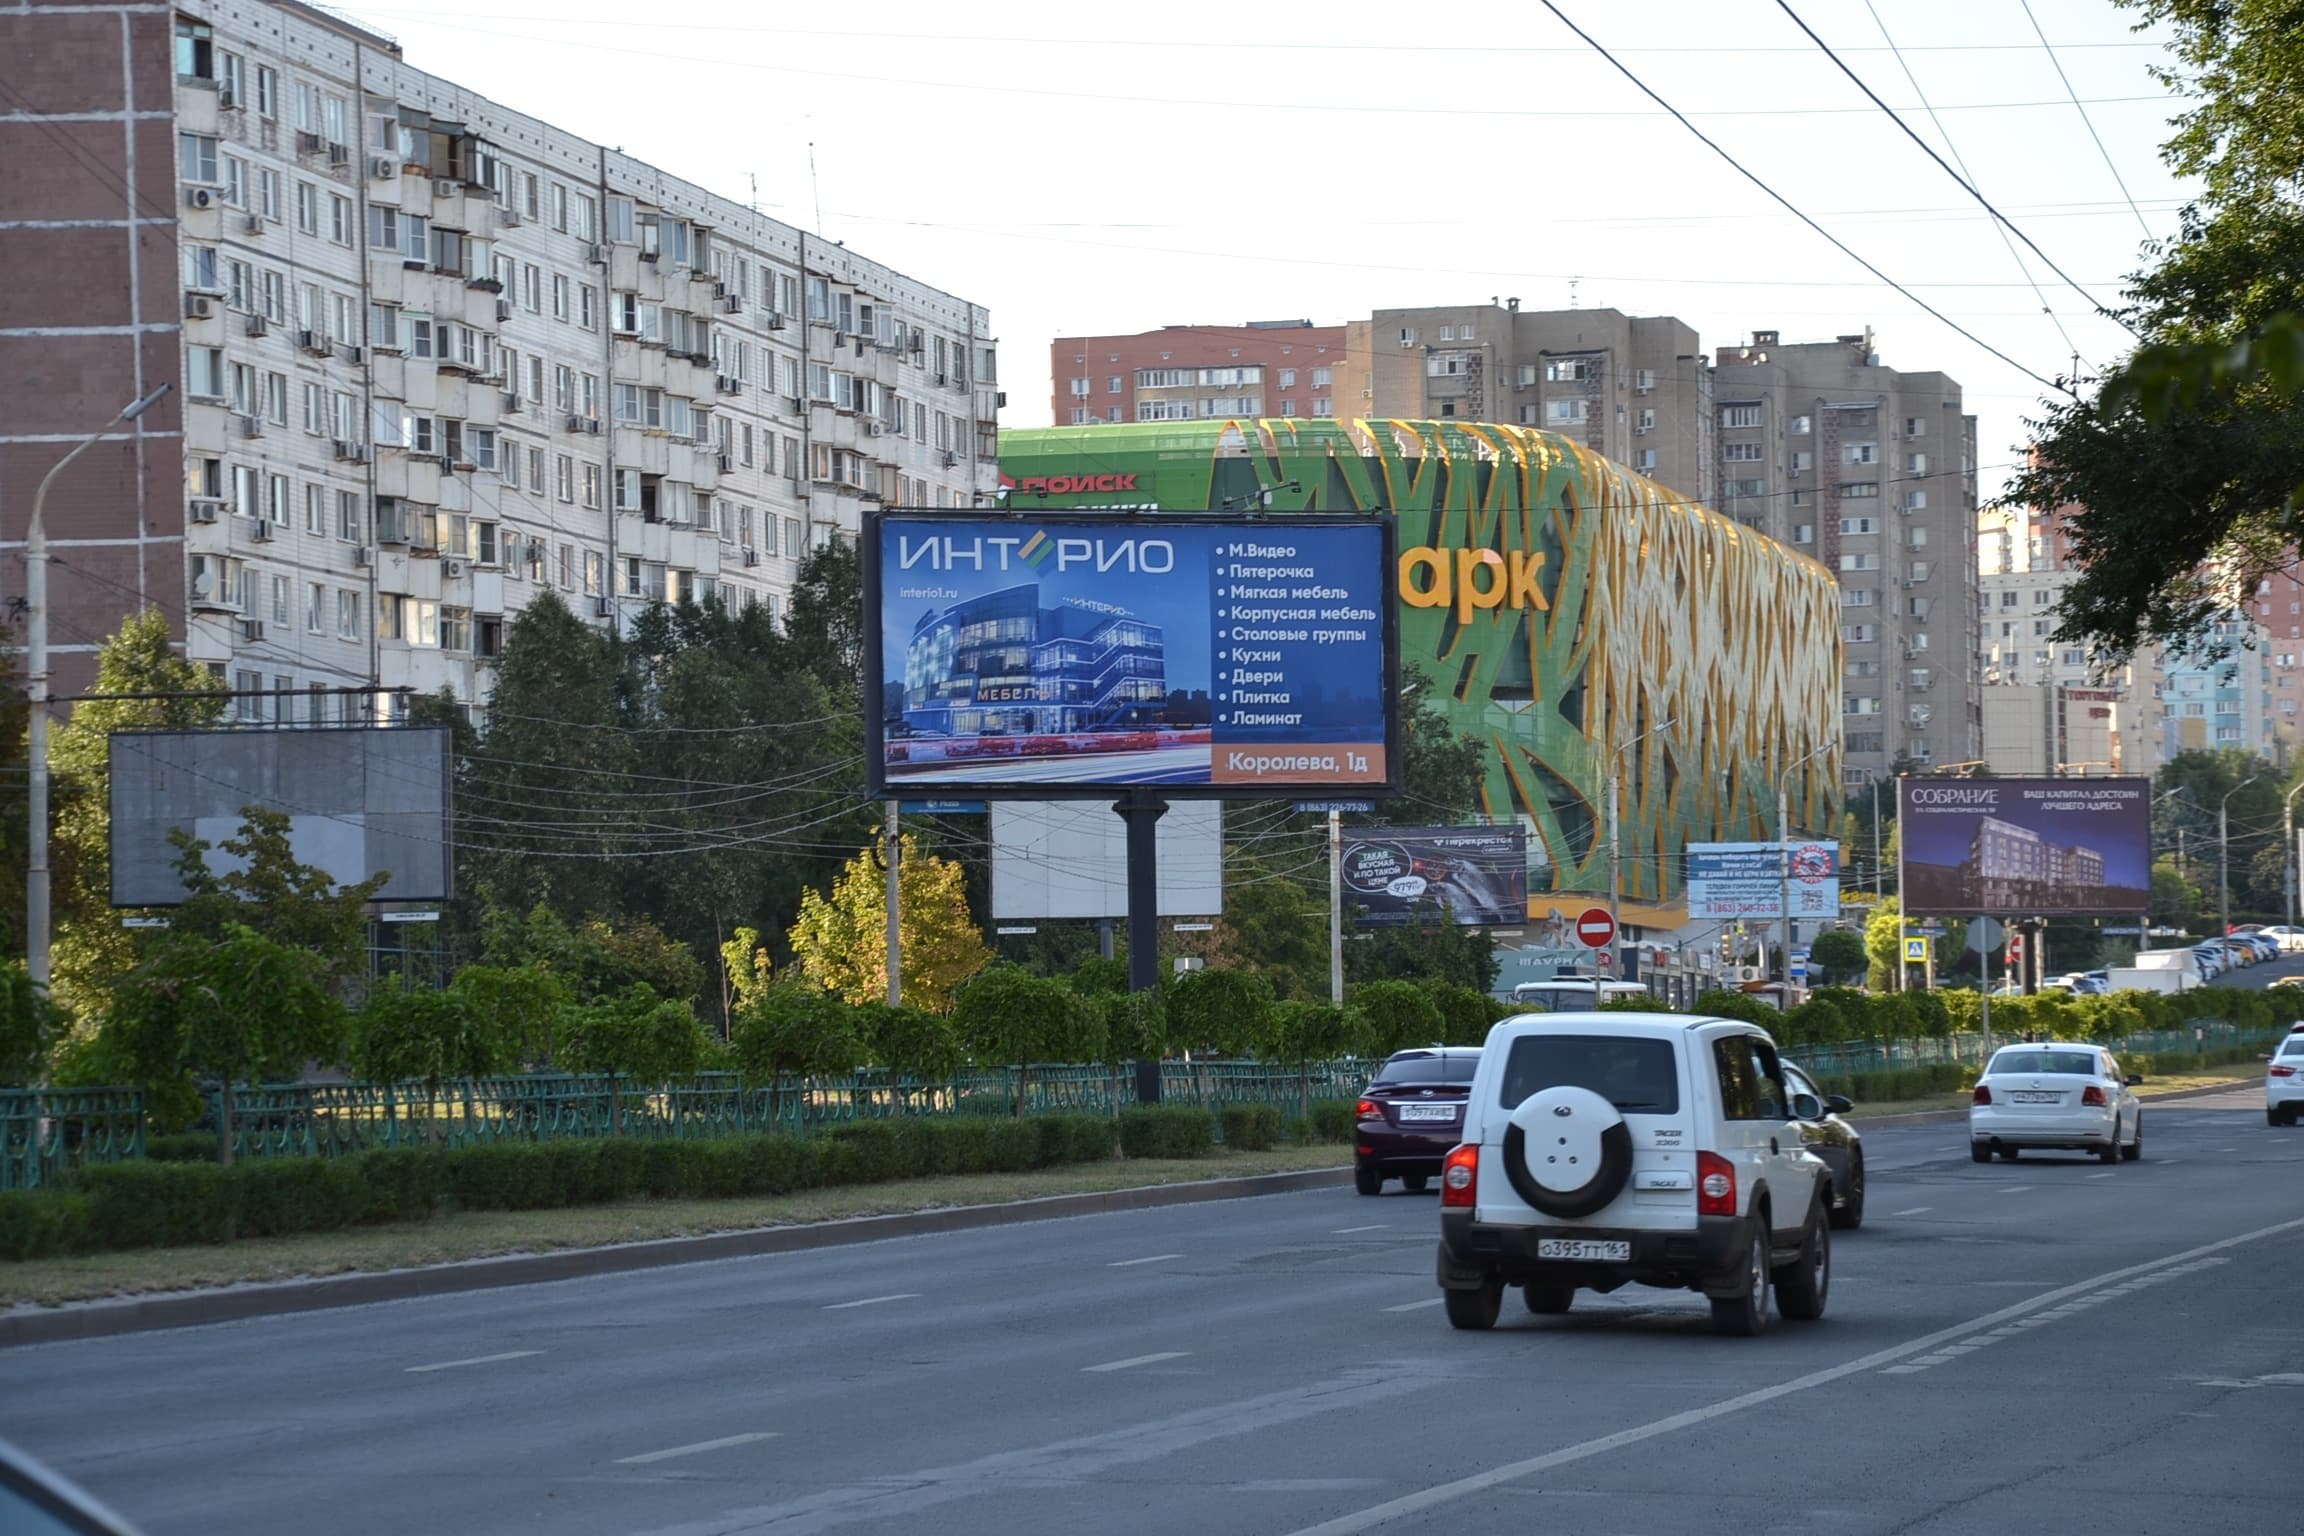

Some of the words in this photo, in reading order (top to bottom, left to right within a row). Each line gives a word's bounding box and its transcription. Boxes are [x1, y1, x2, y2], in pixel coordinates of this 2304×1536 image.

[1022, 474, 1137, 494] ПОИСК
[1229, 543, 1296, 559] М.Видео
[1230, 564, 1314, 581] Пятерочка
[900, 587, 958, 599] interio1.ru
[1231, 585, 1287, 599] Мягкая
[1292, 586, 1348, 599] мебель
[1231, 606, 1316, 623] Корпусная
[1321, 607, 1376, 620] мебель
[1232, 627, 1308, 641] Столовые
[1313, 630, 1366, 644] группы
[1232, 648, 1281, 664] Кухни
[1232, 669, 1283, 686] Двери
[1232, 690, 1290, 704] Плитка
[1232, 711, 1302, 725] Ламинат
[1229, 752, 1340, 775] Королева,
[1346, 752, 1368, 772] 1д
[1911, 788, 2001, 804] СОБРАНИЕ
[2024, 790, 2045, 799] ВАШ
[2046, 790, 2091, 799] КАПИТАЛ
[2092, 790, 2139, 800] ДОСТОИН
[2041, 801, 2085, 810] ЛУЧШЕГО
[2086, 801, 2123, 811] АДРЕСА
[1358, 859, 1395, 869] ВКУСНАЯ
[1374, 865, 1401, 876] ТАКОЙ
